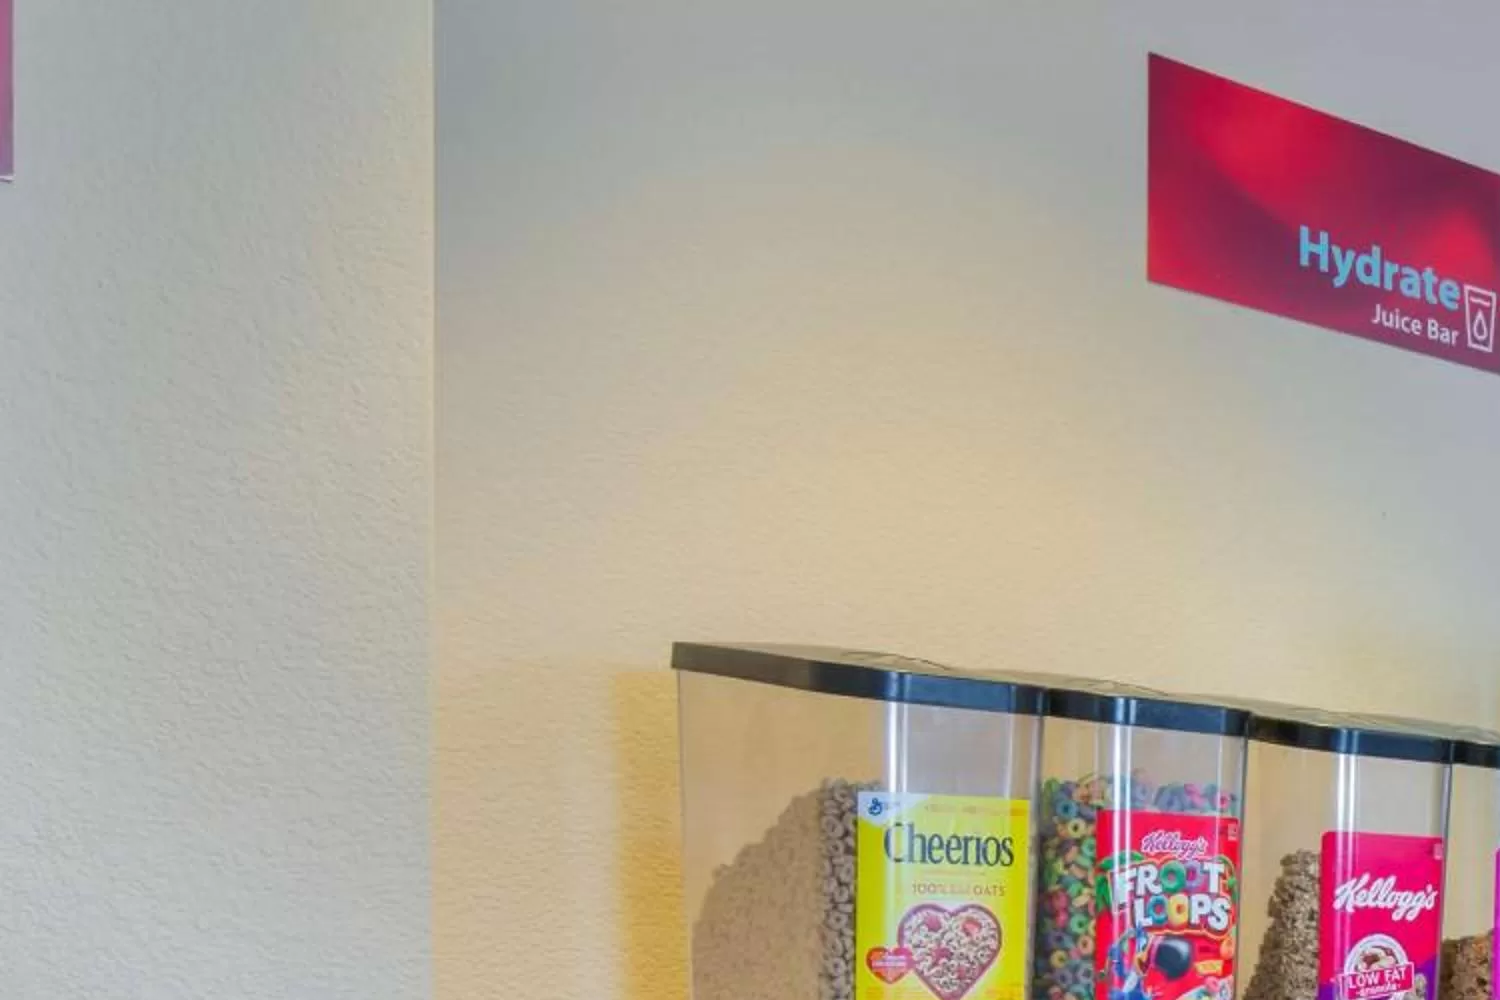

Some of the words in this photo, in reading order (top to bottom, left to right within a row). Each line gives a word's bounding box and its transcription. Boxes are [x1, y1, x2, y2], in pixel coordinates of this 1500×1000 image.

[1299, 224, 1460, 310] Hydrate
[1372, 304, 1421, 336] Juice
[1427, 318, 1460, 345] Bar
[884, 821, 1015, 867] Cheerios
[1111, 860, 1226, 914] FROOT
[1333, 872, 1438, 920] Kellogg's
[1133, 893, 1232, 931] LOOPS
[1348, 970, 1380, 989] LOW
[1384, 966, 1406, 982] FAT
